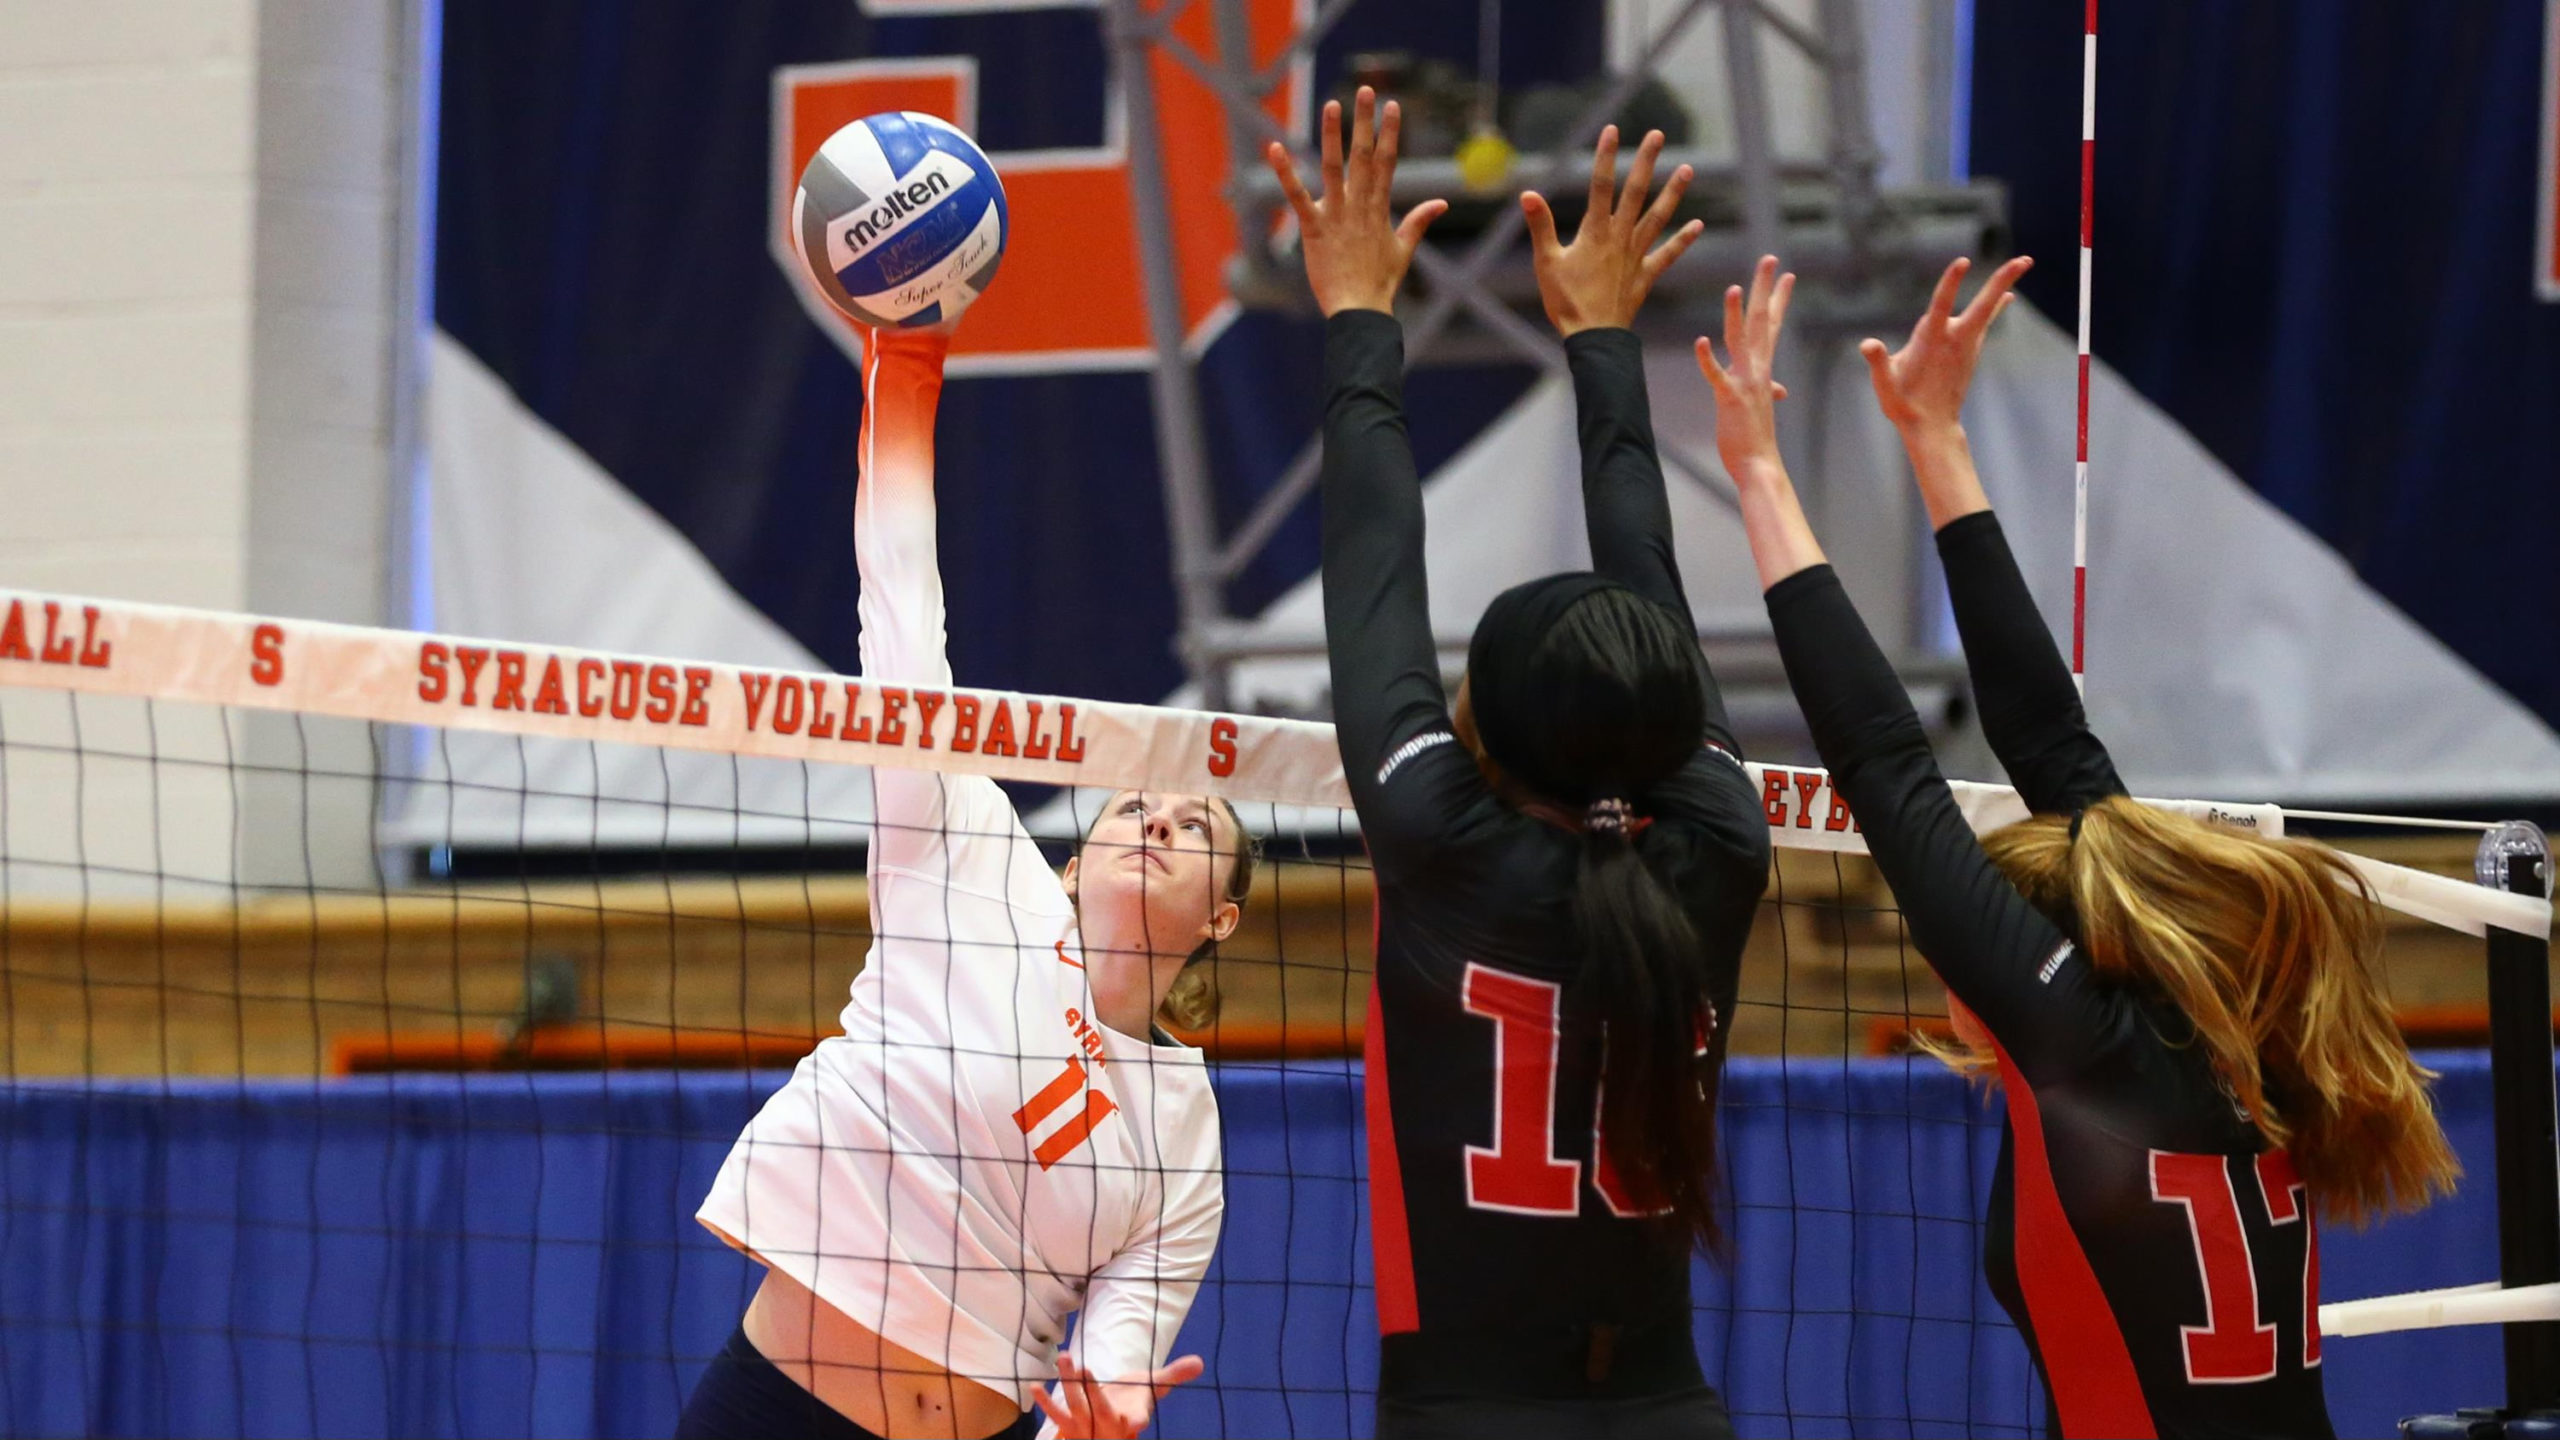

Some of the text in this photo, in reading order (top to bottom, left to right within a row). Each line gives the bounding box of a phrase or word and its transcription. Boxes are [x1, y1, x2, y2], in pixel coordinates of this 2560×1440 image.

[844, 171, 949, 253] molten
[894, 280, 943, 306] Super
[947, 234, 988, 279] Touch
[0, 598, 1862, 833] ALL S SYRACUSE VOLLEYBALL S EYB
[2220, 811, 2258, 828] Senoh
[1011, 1053, 1120, 1172] 11
